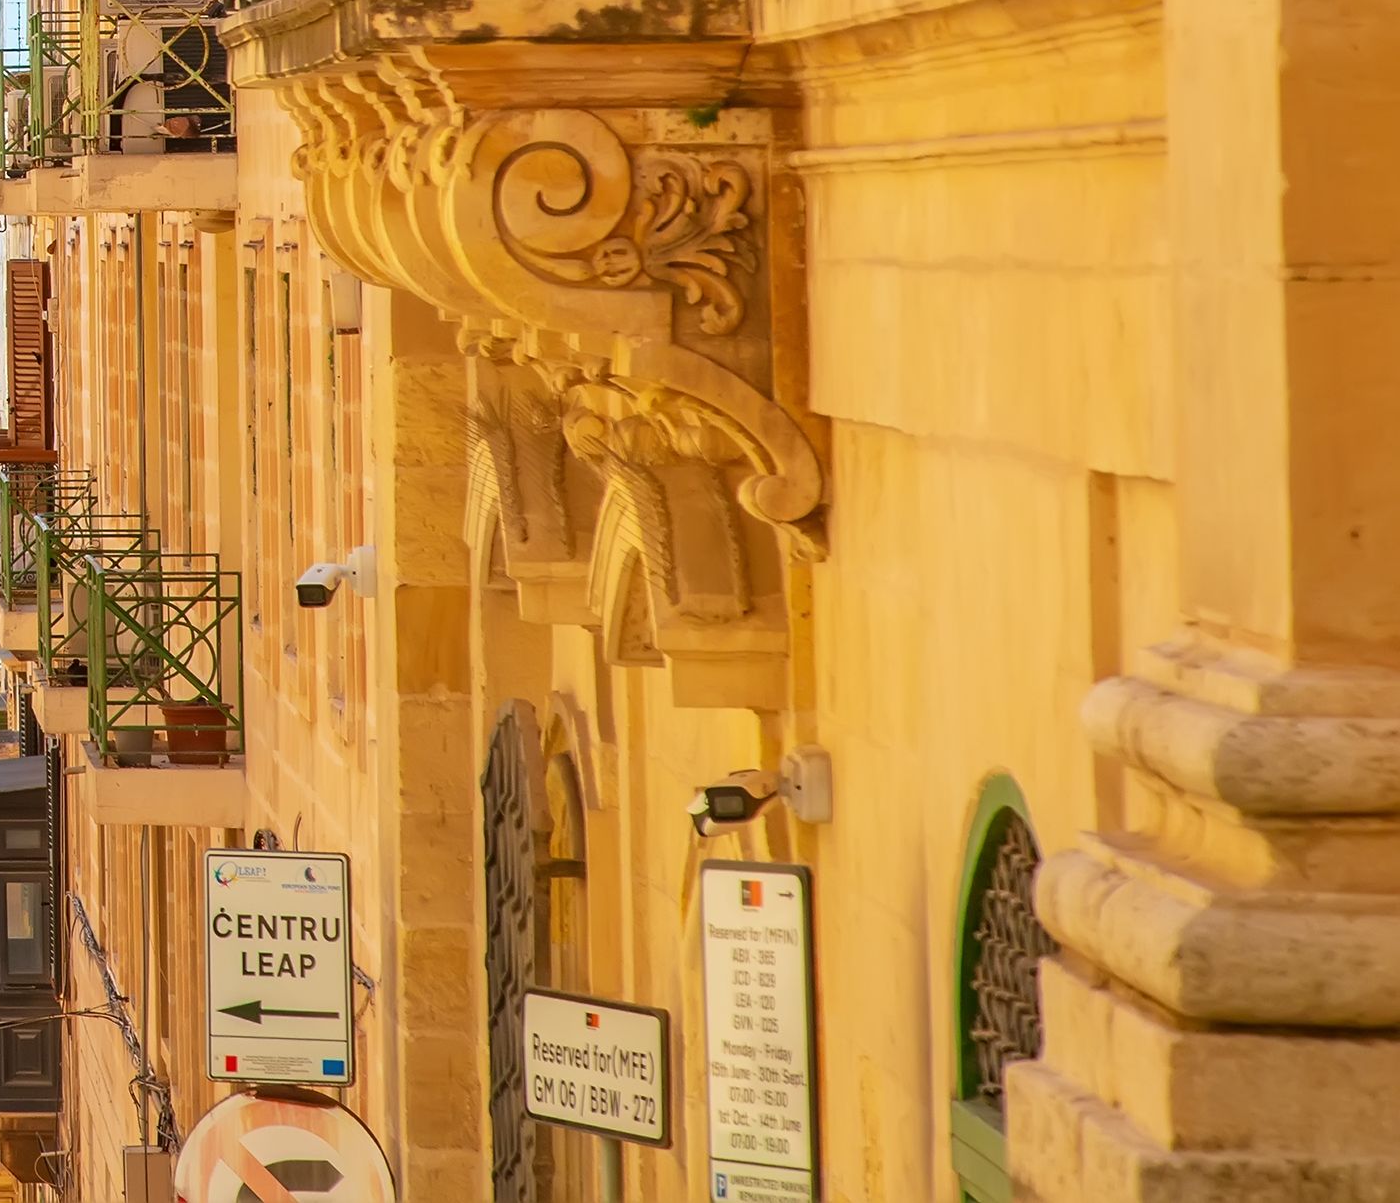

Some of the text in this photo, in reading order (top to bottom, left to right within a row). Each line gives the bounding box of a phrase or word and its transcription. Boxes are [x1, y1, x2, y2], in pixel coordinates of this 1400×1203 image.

[212, 907, 342, 942] ĊENTRU
[709, 923, 748, 941] Reserved
[241, 951, 317, 979] LEAP
[532, 1032, 590, 1070] Reserved
[722, 1040, 757, 1061] Monday
[764, 1043, 793, 1065] Friday
[732, 1064, 751, 1080] June
[534, 1074, 555, 1105] GM
[559, 1080, 577, 1110] 06
[590, 1085, 622, 1118] BBW
[633, 1094, 656, 1126] 272
[781, 1115, 802, 1133] June
